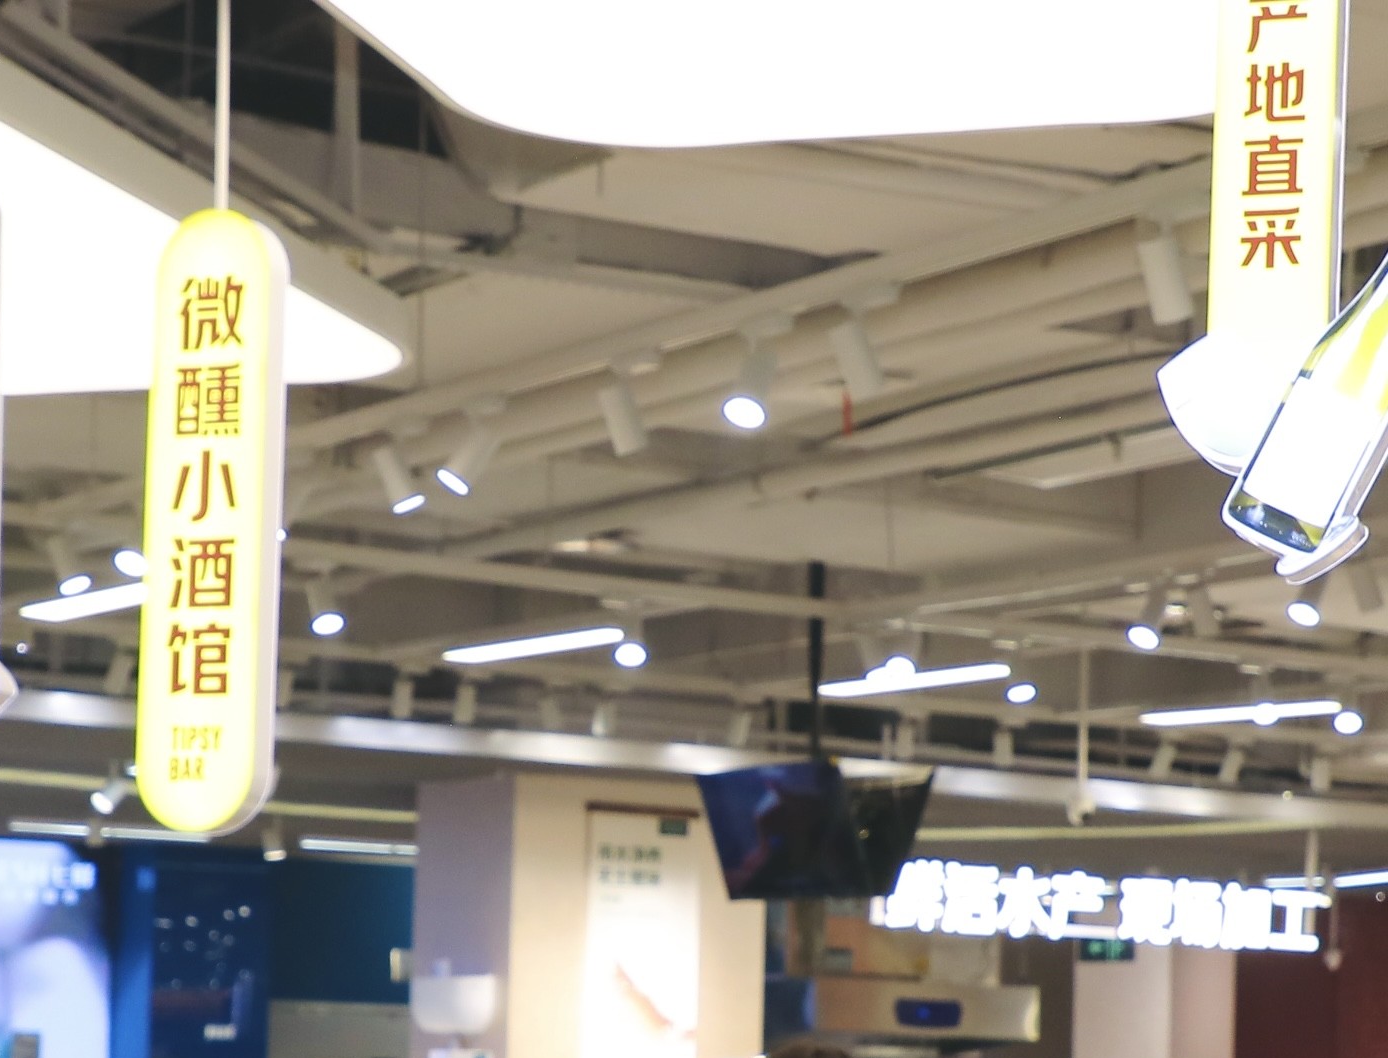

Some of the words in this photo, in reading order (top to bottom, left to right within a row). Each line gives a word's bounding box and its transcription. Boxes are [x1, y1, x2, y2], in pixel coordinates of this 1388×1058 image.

[1240, 0, 1308, 269] 产地直采
[167, 275, 243, 697] 微醺小酒馆
[169, 756, 206, 782] BAR
[170, 727, 224, 753] TIPSY
